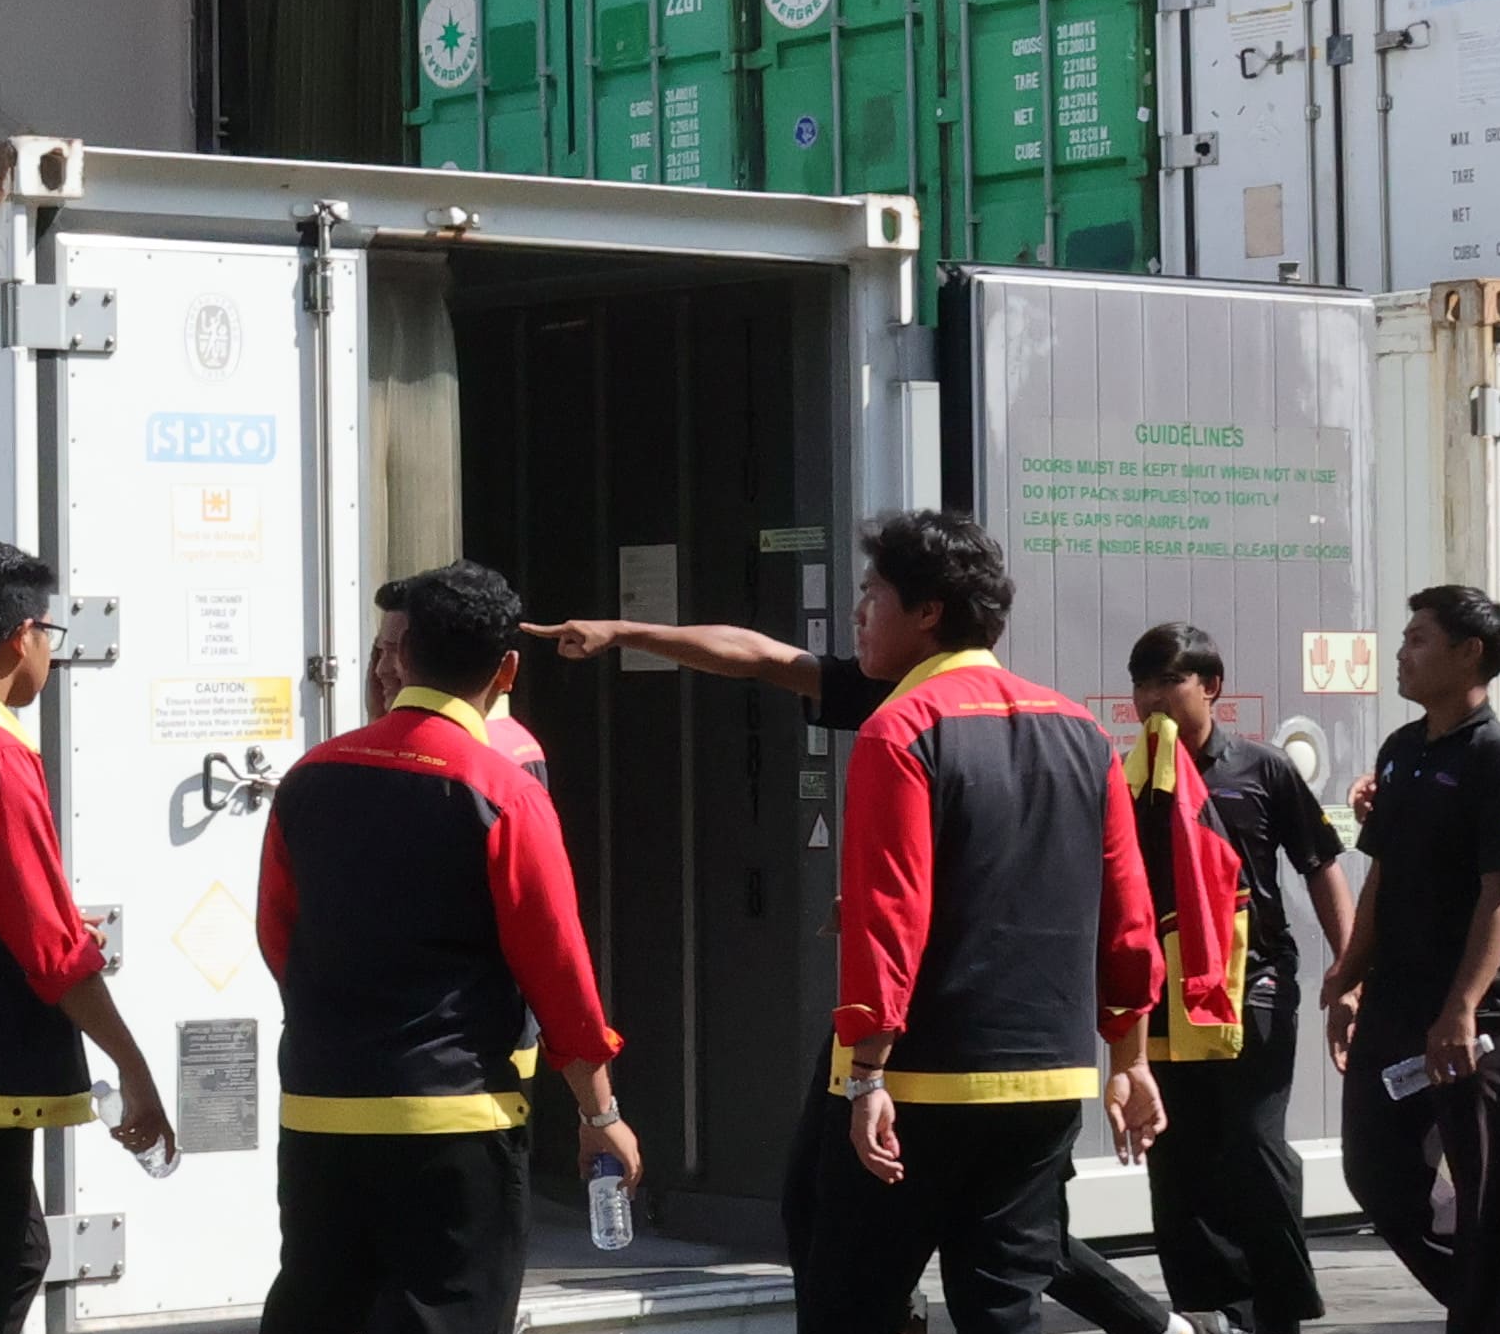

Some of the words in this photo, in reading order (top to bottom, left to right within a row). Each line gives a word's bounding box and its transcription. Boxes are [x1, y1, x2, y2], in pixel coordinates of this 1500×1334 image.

[425, 36, 478, 81] EVERGREEN
[1014, 72, 1039, 91] TARE
[1014, 108, 1034, 125] NET
[1015, 141, 1042, 160] CUBE
[153, 415, 271, 460] SPRO
[1136, 423, 1244, 448] GUIDELINES
[1022, 458, 1072, 473] DOORS
[1077, 460, 1114, 475] MUST
[1119, 462, 1137, 476] BE
[1143, 463, 1177, 478] KEPT
[1221, 465, 1259, 481] WHEN
[1264, 467, 1289, 482] NOT
[1311, 469, 1336, 484] USE
[1023, 485, 1044, 499] DO
[1049, 486, 1075, 500] NOT
[1081, 487, 1118, 501] PACK
[1122, 488, 1189, 504] SUPPLIES
[1193, 490, 1220, 504] TOO
[1023, 512, 1068, 526] LEAVE
[1073, 513, 1111, 527] GAPS
[1116, 514, 1146, 528] FOR
[1149, 515, 1210, 530] AIRFLOW
[1023, 539, 1061, 552] KEEP
[1067, 540, 1093, 553] THE
[1097, 540, 1140, 554] INSIDE
[1145, 541, 1182, 555] REAR
[1187, 542, 1231, 556] PANEL
[1281, 544, 1298, 558] OF
[196, 683, 244, 693] CAUTION
